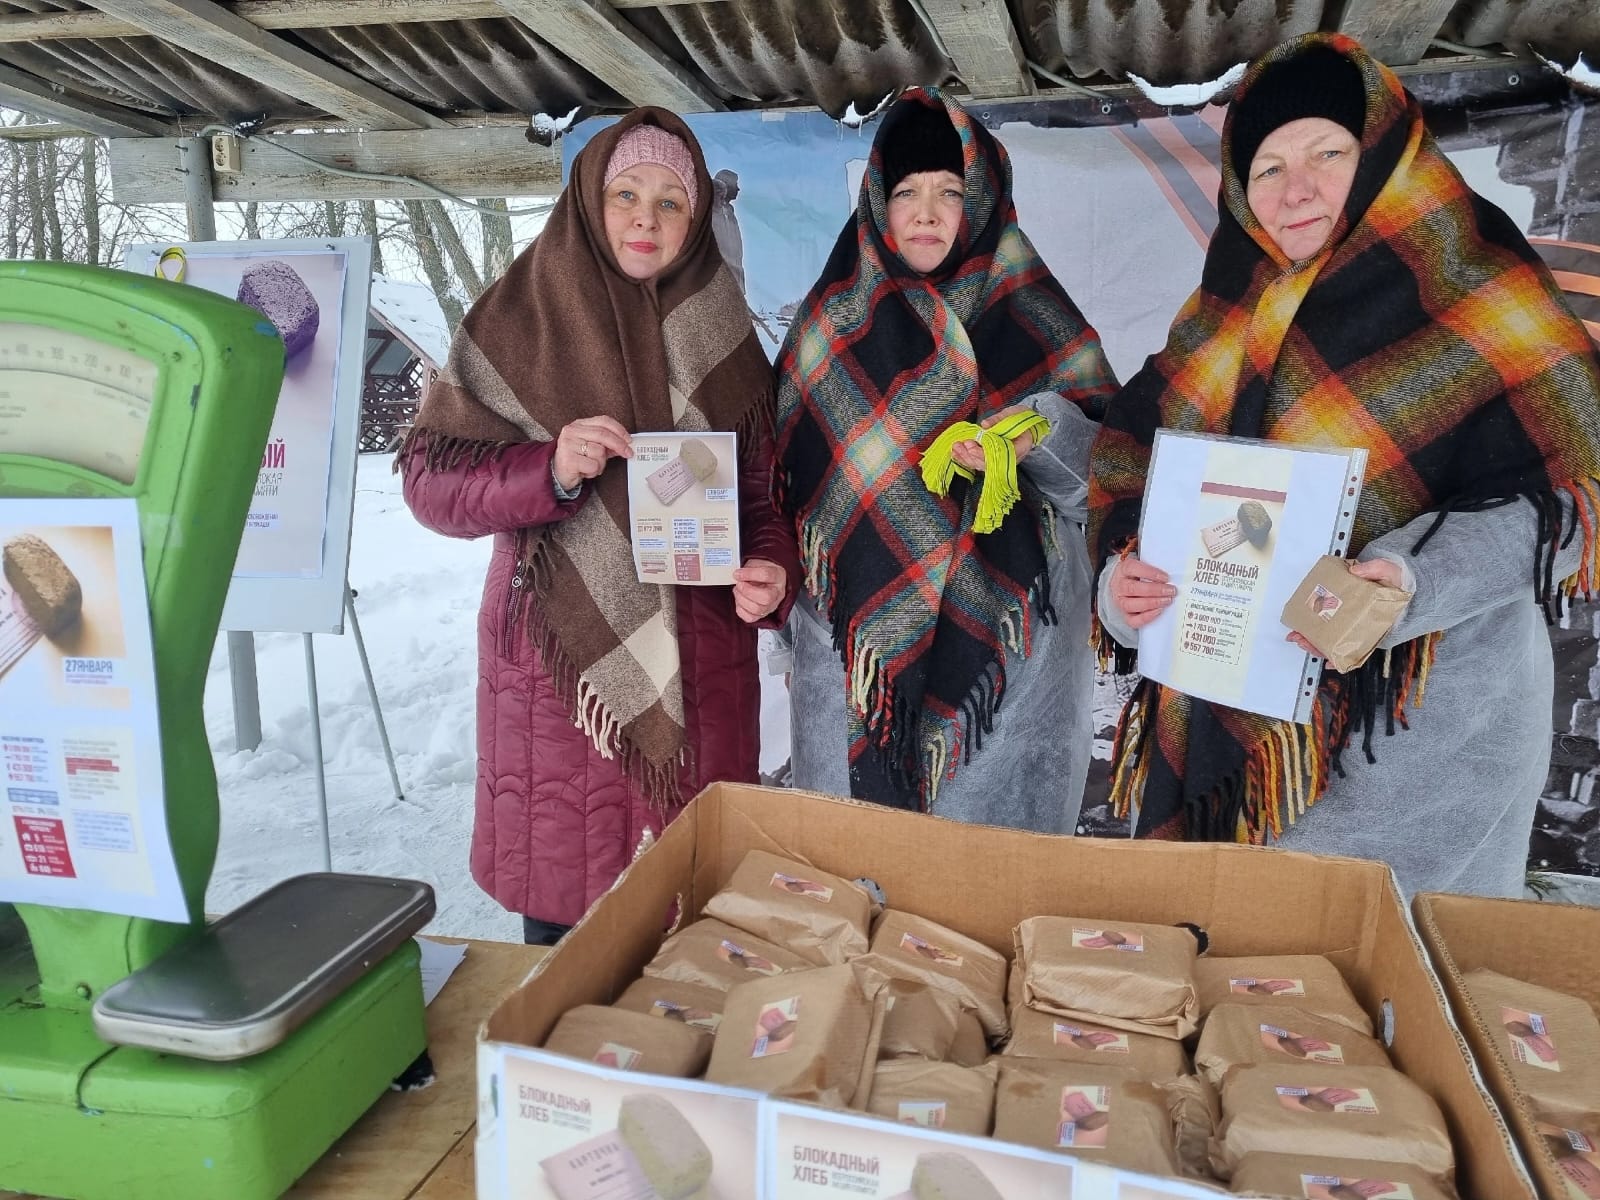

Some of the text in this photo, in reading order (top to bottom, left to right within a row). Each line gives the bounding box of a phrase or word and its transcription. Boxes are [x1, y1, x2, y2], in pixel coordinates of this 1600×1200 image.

[1193, 570, 1221, 586] ХЛЕБ
[1196, 557, 1260, 580] БЛОКАДНЫЙ
[518, 1083, 592, 1116] БЛОКАДНЫЙ
[519, 1102, 550, 1123] ХЛЕБ
[793, 1144, 880, 1176] БЛОКАДНЫЙ
[792, 1163, 829, 1186] ХЛЕБ
